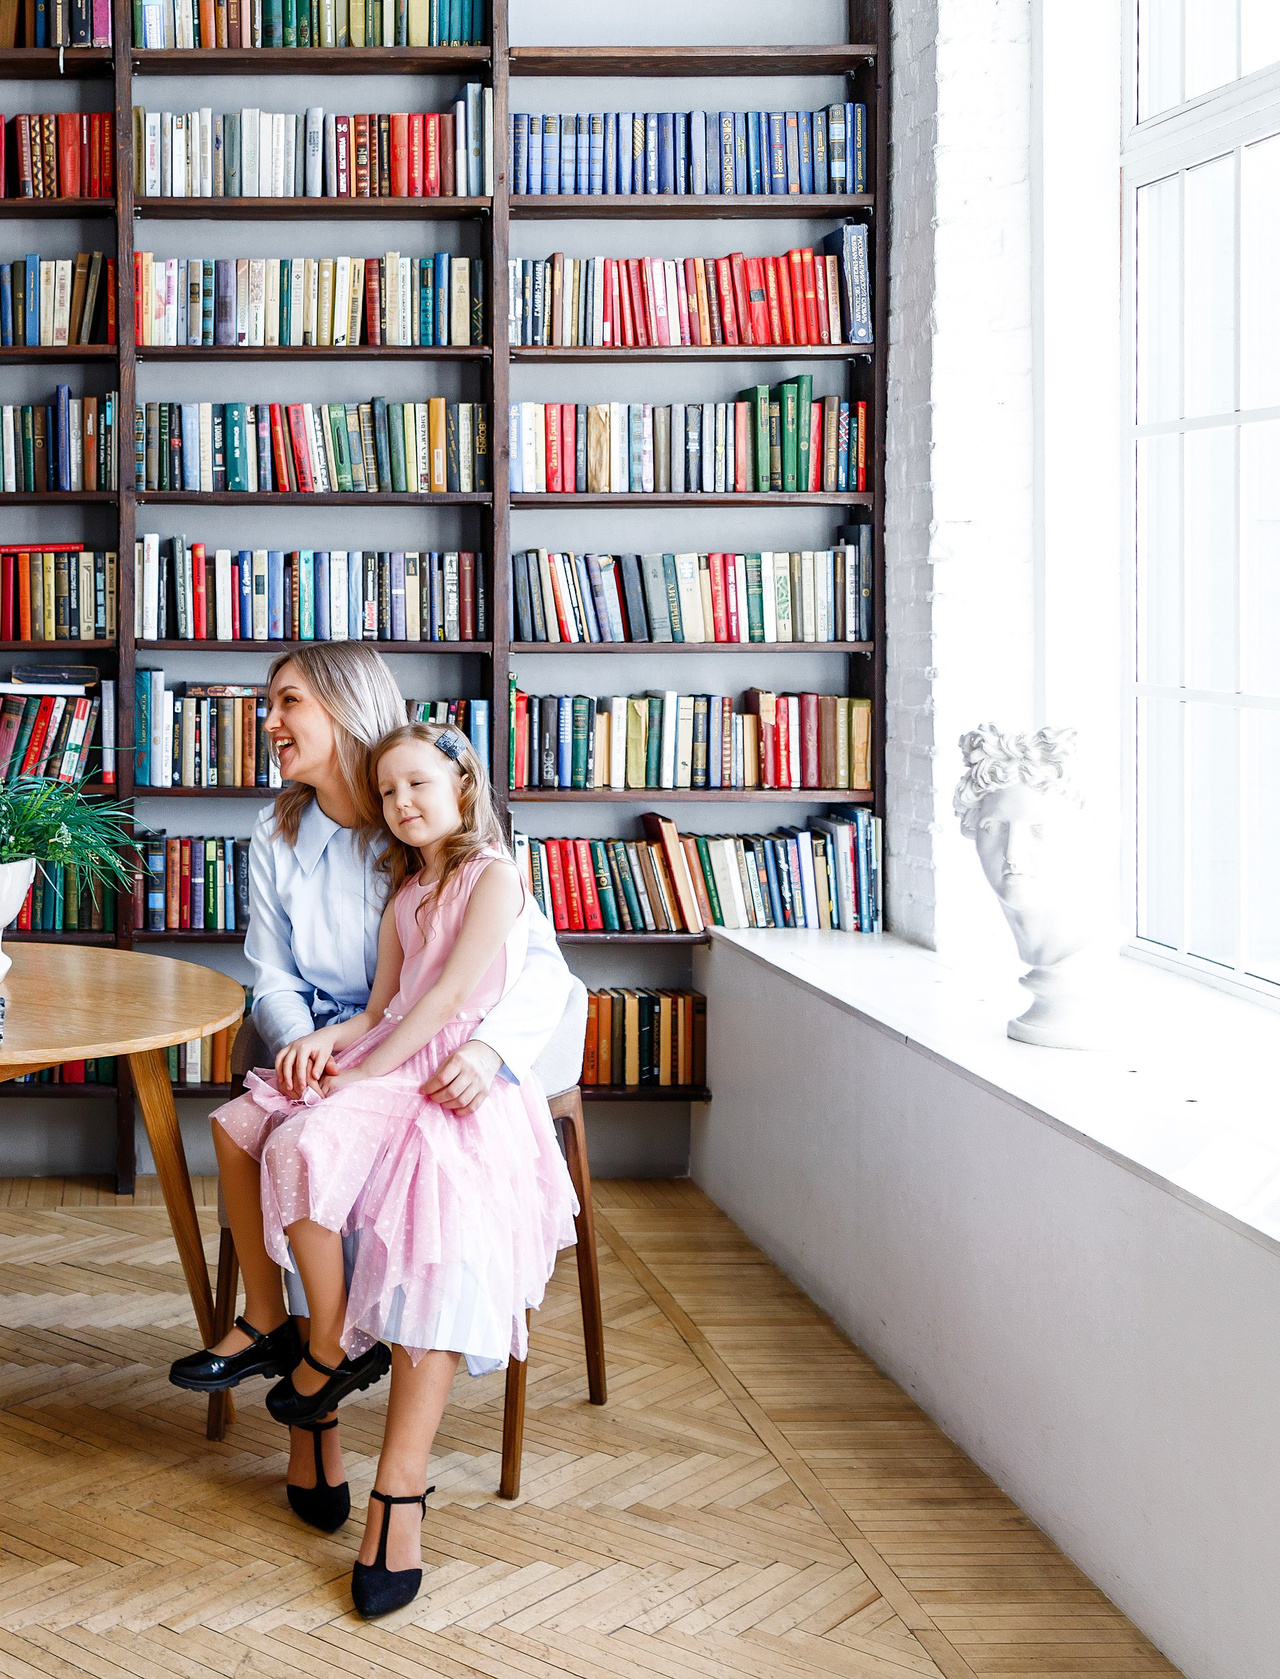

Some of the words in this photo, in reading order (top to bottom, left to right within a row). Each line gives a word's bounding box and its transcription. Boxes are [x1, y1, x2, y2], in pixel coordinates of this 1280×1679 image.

[851, 234, 860, 285] RUSSIAN-ENGLISH
[856, 235, 867, 296] РУССКО-АНГЛИЙСКИЙ
[854, 286, 862, 323] DICTIONARY
[860, 297, 868, 324] СЛОВАРЬ
[365, 601, 375, 629] МАФИЯ
[447, 592, 457, 620] Банда
